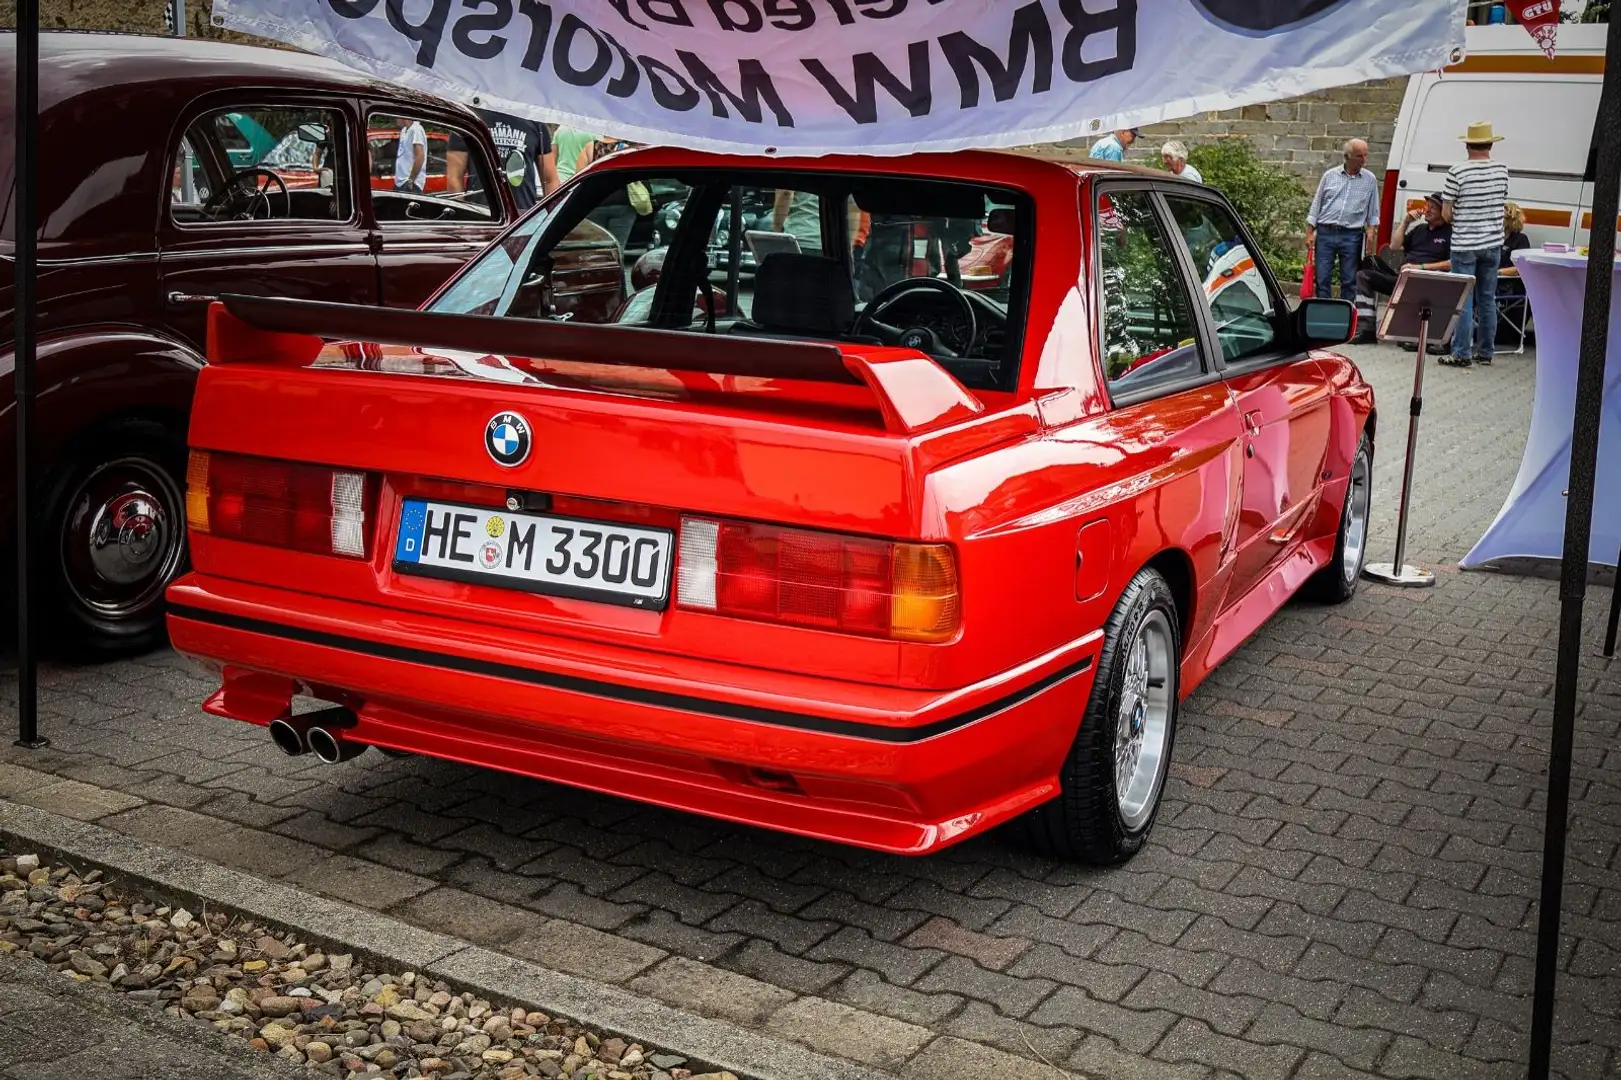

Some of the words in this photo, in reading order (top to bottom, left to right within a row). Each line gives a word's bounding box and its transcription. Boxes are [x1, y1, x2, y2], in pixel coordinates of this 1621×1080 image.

[488, 127, 527, 141] HMANN
[490, 415, 525, 434] BMW
[405, 538, 415, 551] D
[421, 509, 477, 563] HE
[506, 521, 537, 571] M
[546, 525, 659, 588] 3300
